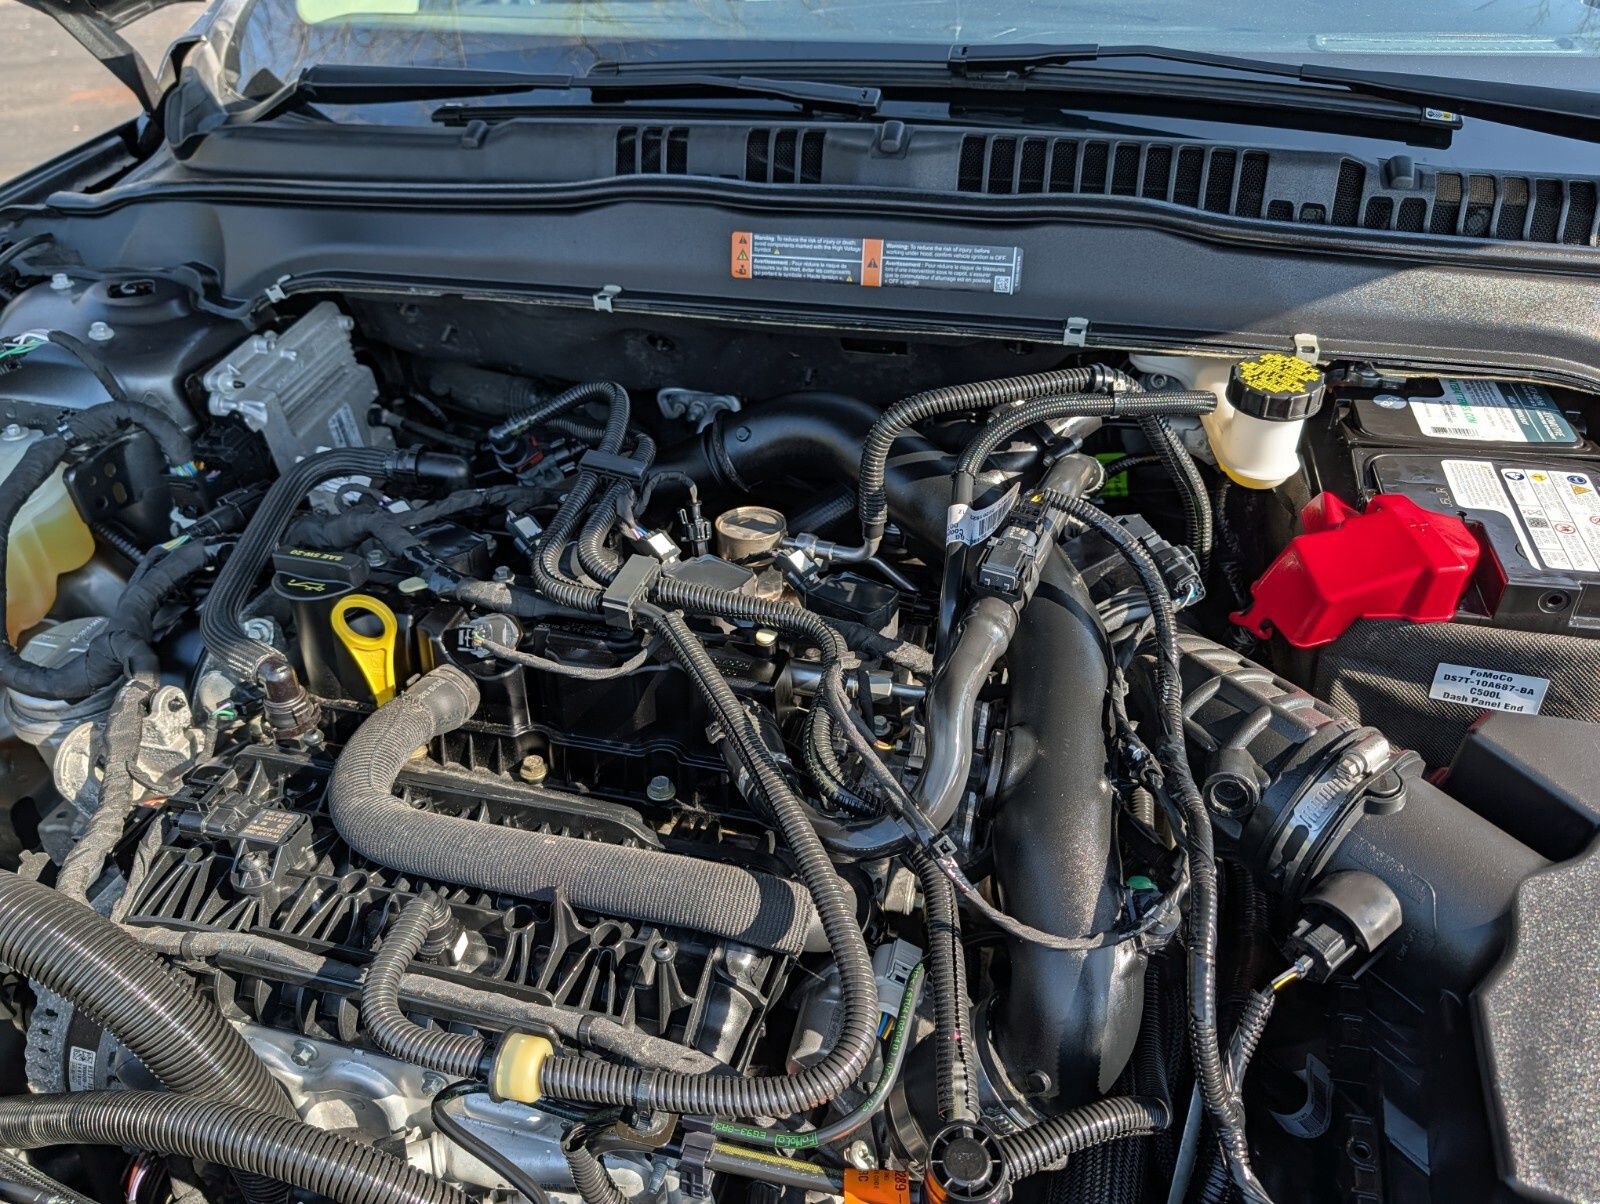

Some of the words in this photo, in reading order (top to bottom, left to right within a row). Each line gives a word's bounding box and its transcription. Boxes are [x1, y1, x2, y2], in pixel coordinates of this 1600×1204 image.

[1470, 670, 1514, 682] FoMoCo
[1443, 674, 1534, 696] DS7T-10A687-BA
[1470, 688, 1501, 700] C500L
[1442, 692, 1468, 703] Dash
[1471, 697, 1500, 709] Panel
[1504, 703, 1524, 712] End
[778, 1132, 816, 1146] FoMoCo
